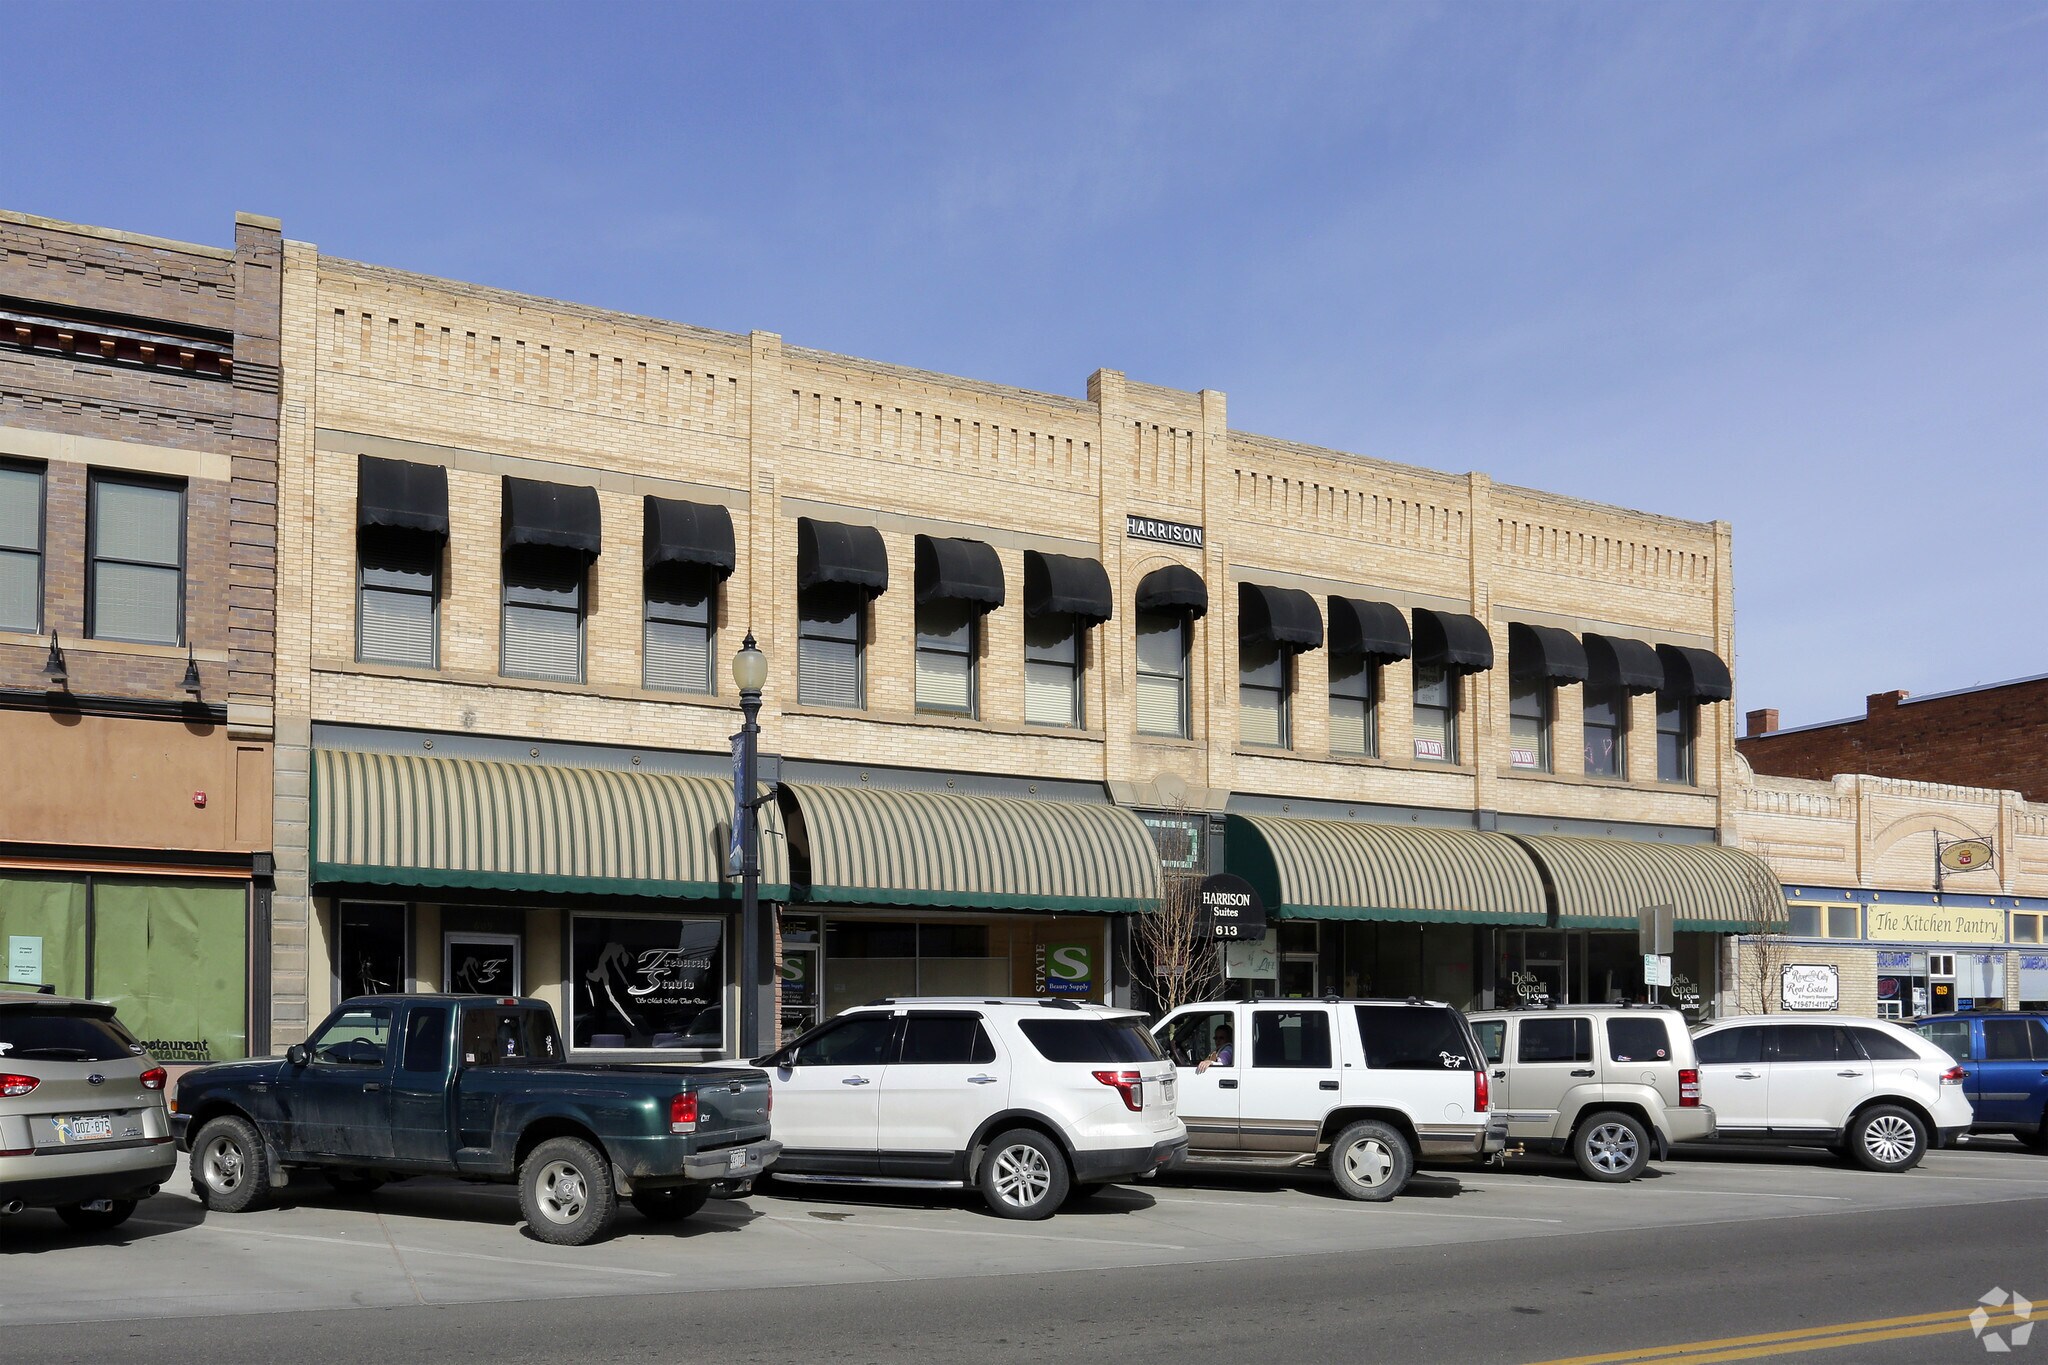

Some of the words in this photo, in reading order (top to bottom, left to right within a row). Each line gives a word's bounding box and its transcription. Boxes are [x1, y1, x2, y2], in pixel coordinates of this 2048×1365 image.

[1126, 518, 1202, 544] HARRISON
[1418, 741, 1429, 753] FOR
[1429, 743, 1441, 755] RENT
[1511, 751, 1522, 763] FOR
[1522, 752, 1533, 764] RENT
[1202, 891, 1250, 906] HARRISON
[1213, 906, 1239, 917] Suites
[1215, 925, 1238, 936] 613
[1876, 911, 1898, 931] The
[1902, 913, 1951, 933] Kitchen
[1955, 916, 1998, 939] Pantry
[1035, 944, 1046, 993] STATE
[1050, 946, 1089, 980] S
[1511, 971, 1538, 985] Bella
[1049, 983, 1068, 991] Beauty
[1068, 983, 1089, 991] Supply
[1516, 982, 1548, 1000] Capelli
[1671, 983, 1698, 1000] Capelli
[1786, 982, 1805, 995] Real
[1806, 982, 1829, 993] Estate
[1936, 985, 1948, 995] 619
[1793, 1000, 1829, 1008] 719-671-4117
[140, 1038, 208, 1052] estaurant
